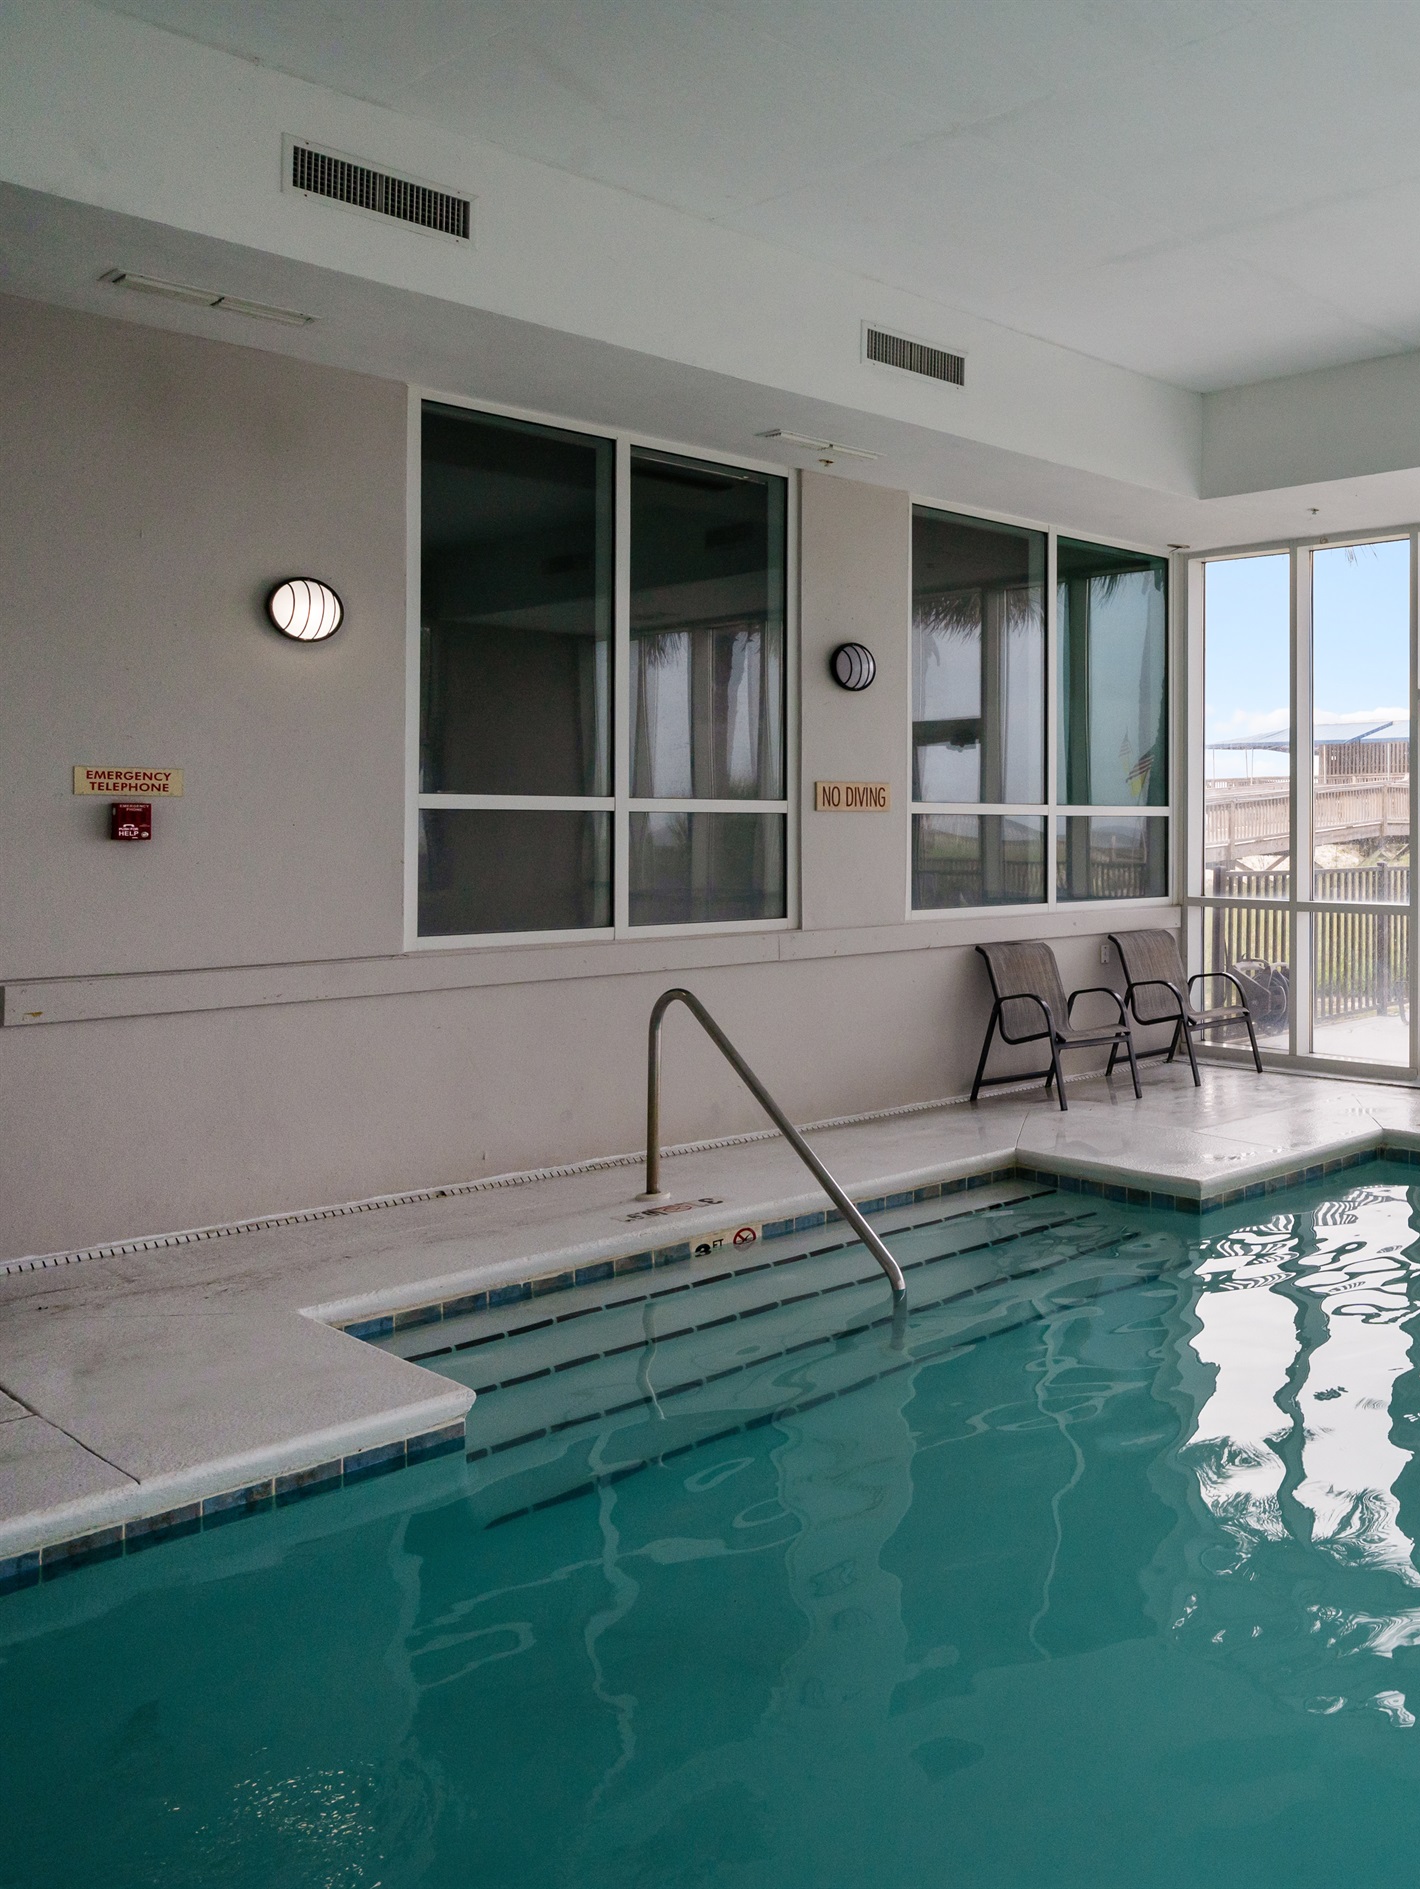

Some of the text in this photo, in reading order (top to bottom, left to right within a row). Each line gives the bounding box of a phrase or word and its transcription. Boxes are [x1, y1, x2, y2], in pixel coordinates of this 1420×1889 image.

[86, 770, 171, 781] EMERGENCY
[89, 781, 170, 792] TELEPHONE
[822, 786, 886, 808] NO DIVING
[712, 1238, 724, 1248] FT
